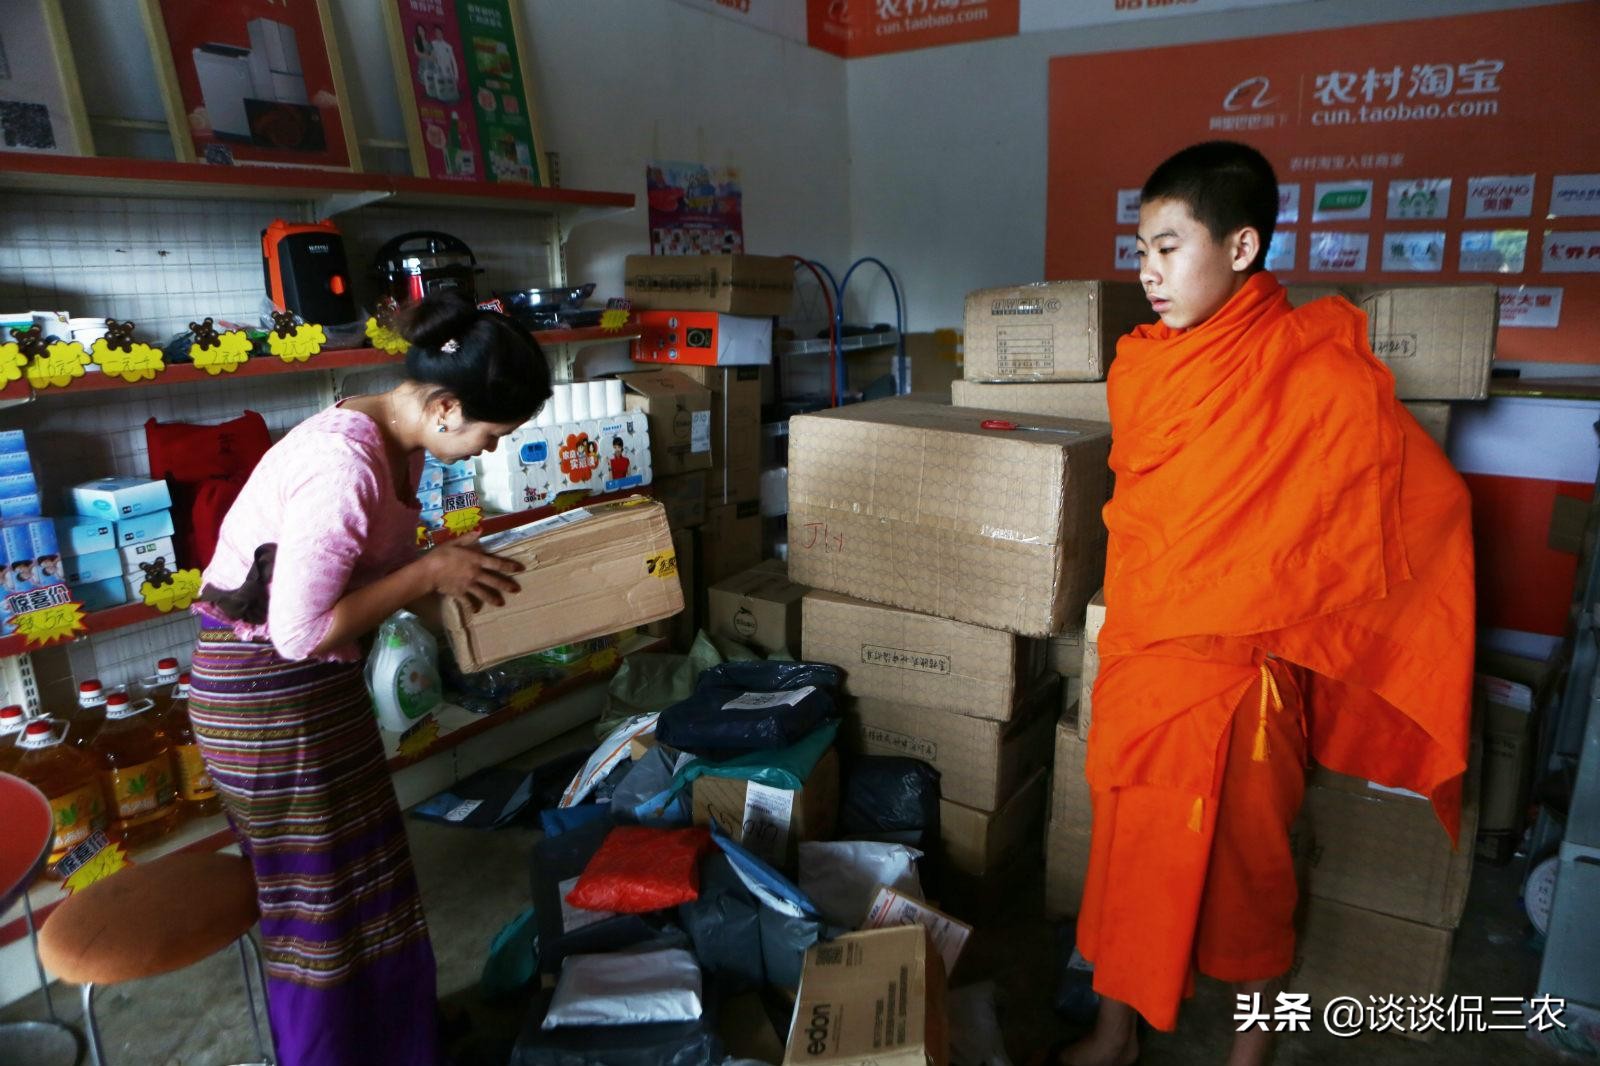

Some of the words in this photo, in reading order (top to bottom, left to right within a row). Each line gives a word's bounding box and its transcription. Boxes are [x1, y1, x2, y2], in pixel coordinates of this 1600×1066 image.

[875, 9, 988, 37] cun.taobao.com
[1313, 60, 1506, 107] 农村淘宝
[1310, 99, 1500, 127] cun.taobao.com
[9, 584, 71, 614] 惊喜价
